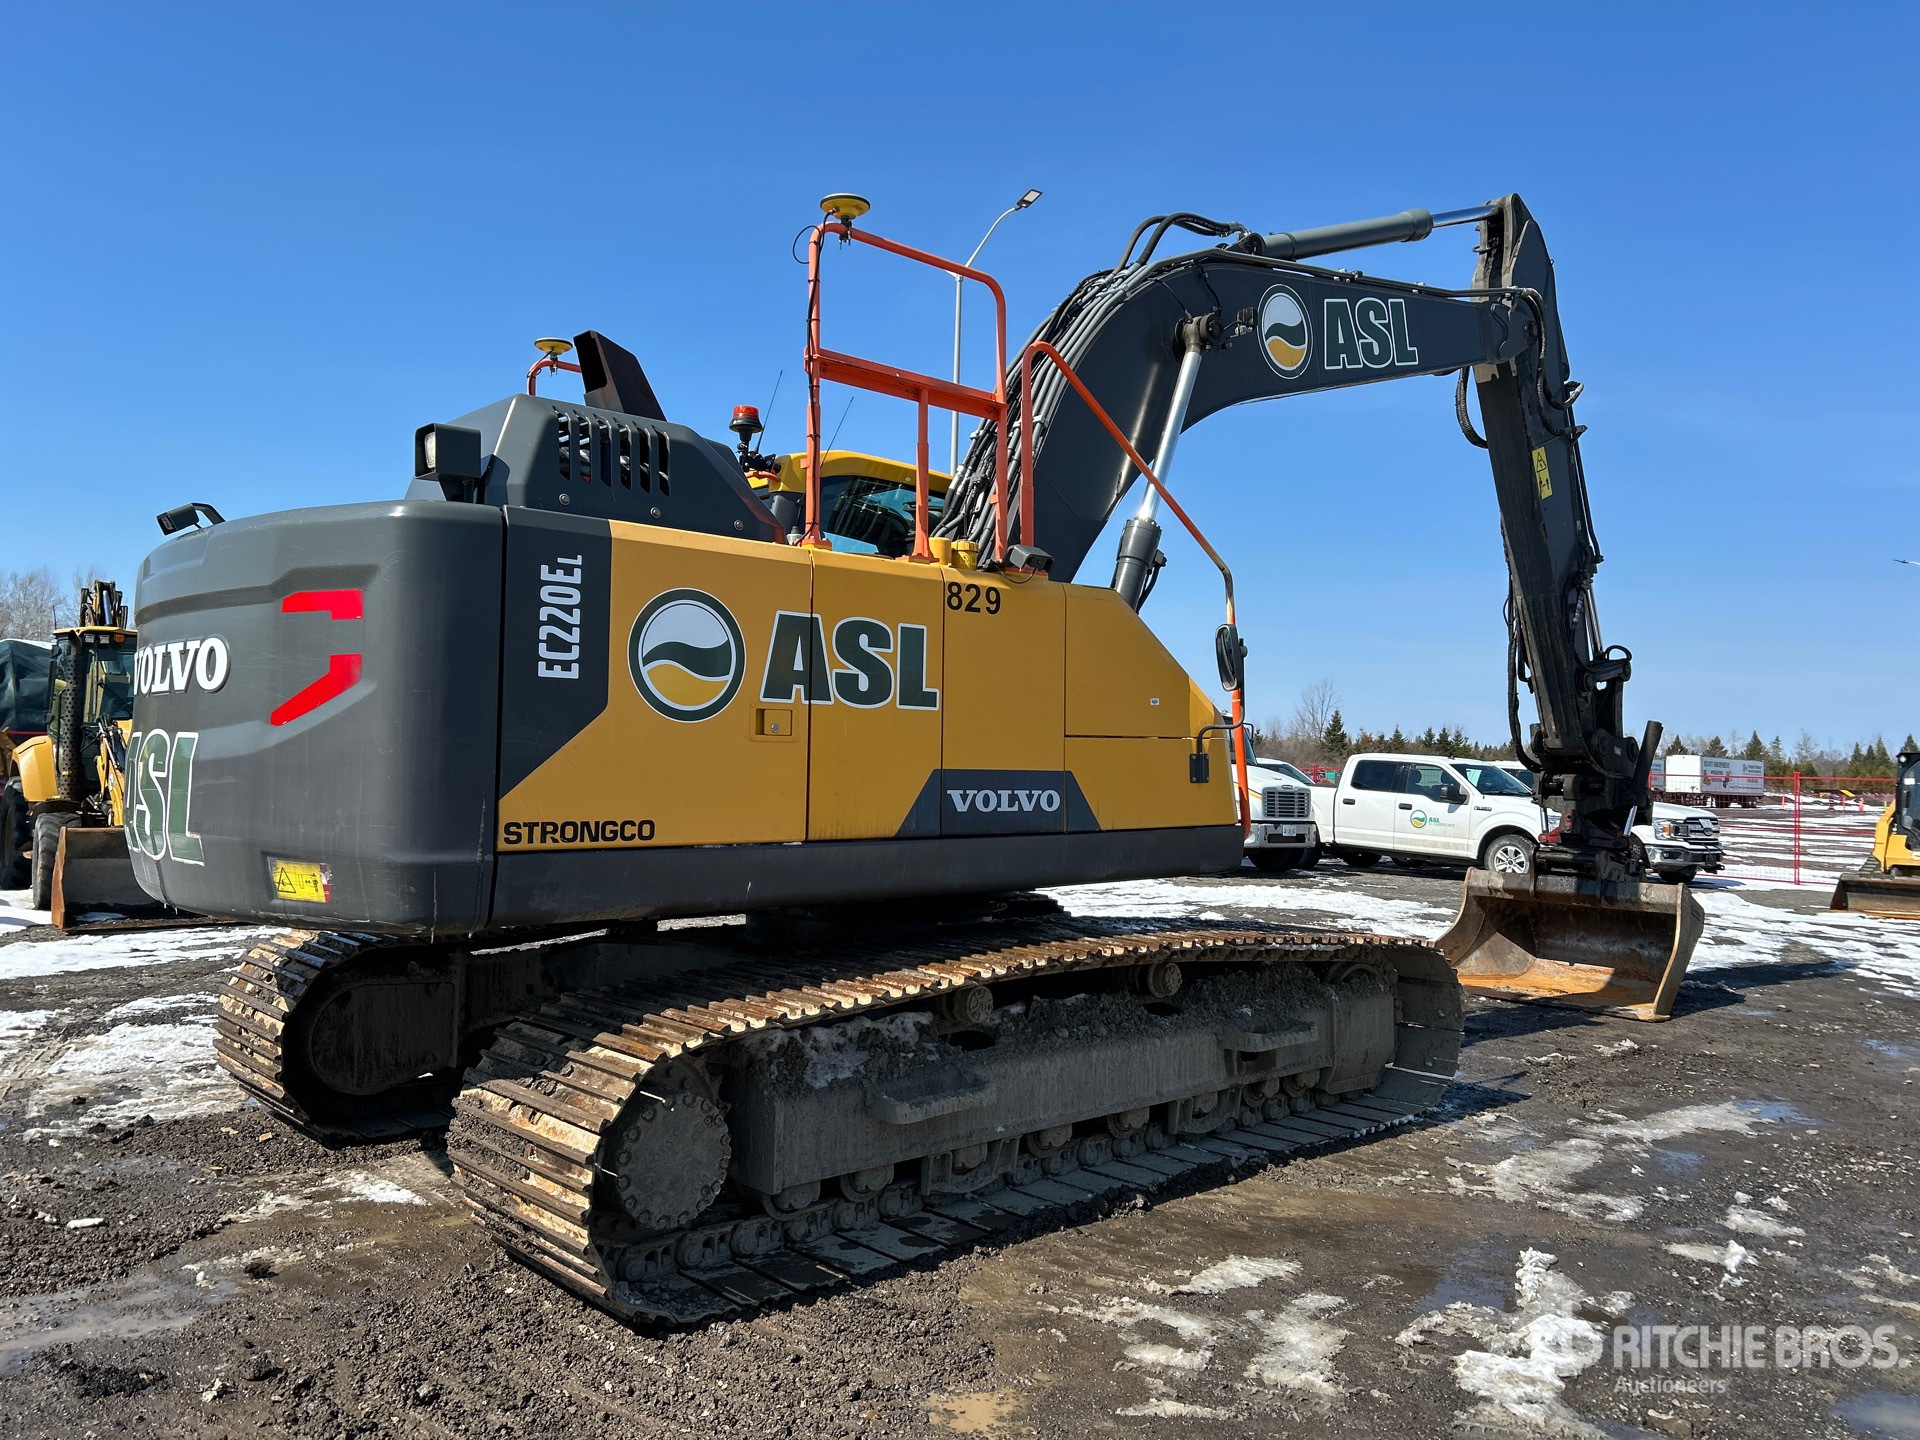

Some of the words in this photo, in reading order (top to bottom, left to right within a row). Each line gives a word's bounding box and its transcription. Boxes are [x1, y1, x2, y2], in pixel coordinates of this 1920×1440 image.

[1324, 298, 1418, 369] ASL
[946, 582, 1000, 614] 829
[133, 636, 229, 695] VOLVO
[759, 610, 939, 711] ASL
[946, 788, 1060, 813] VOLVO
[503, 819, 656, 845] STRONGCO
